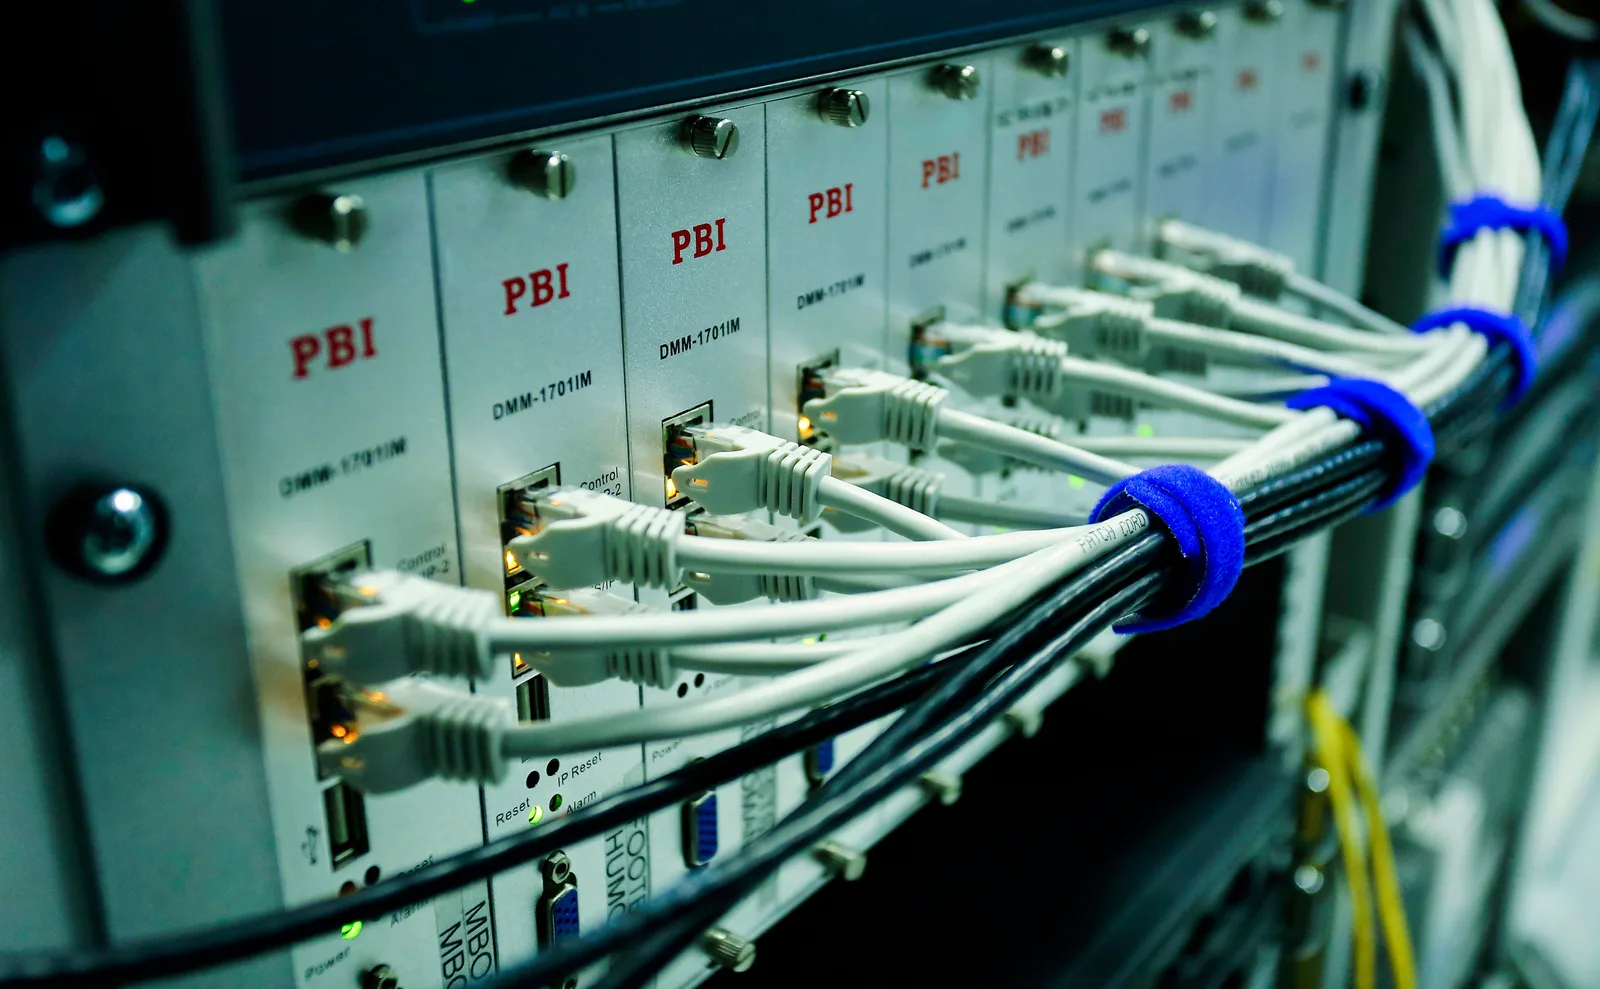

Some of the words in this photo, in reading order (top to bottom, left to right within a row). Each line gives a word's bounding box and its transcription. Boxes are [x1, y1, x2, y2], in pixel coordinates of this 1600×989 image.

[921, 152, 961, 190] PBI
[807, 182, 855, 225] PBI
[671, 217, 727, 266] PBI
[502, 261, 571, 317] PBI
[289, 316, 378, 380] PBI
[659, 316, 741, 361] DMM-1701IM
[492, 369, 593, 421] DMM-1701IM
[279, 435, 407, 498] DMM-1701IM
[1077, 524, 1117, 554] PATCH
[1119, 512, 1147, 537] CORD
[557, 772, 569, 788] IP
[571, 751, 602, 779] Reset
[495, 797, 530, 827] Reset
[566, 790, 597, 815] Alarm
